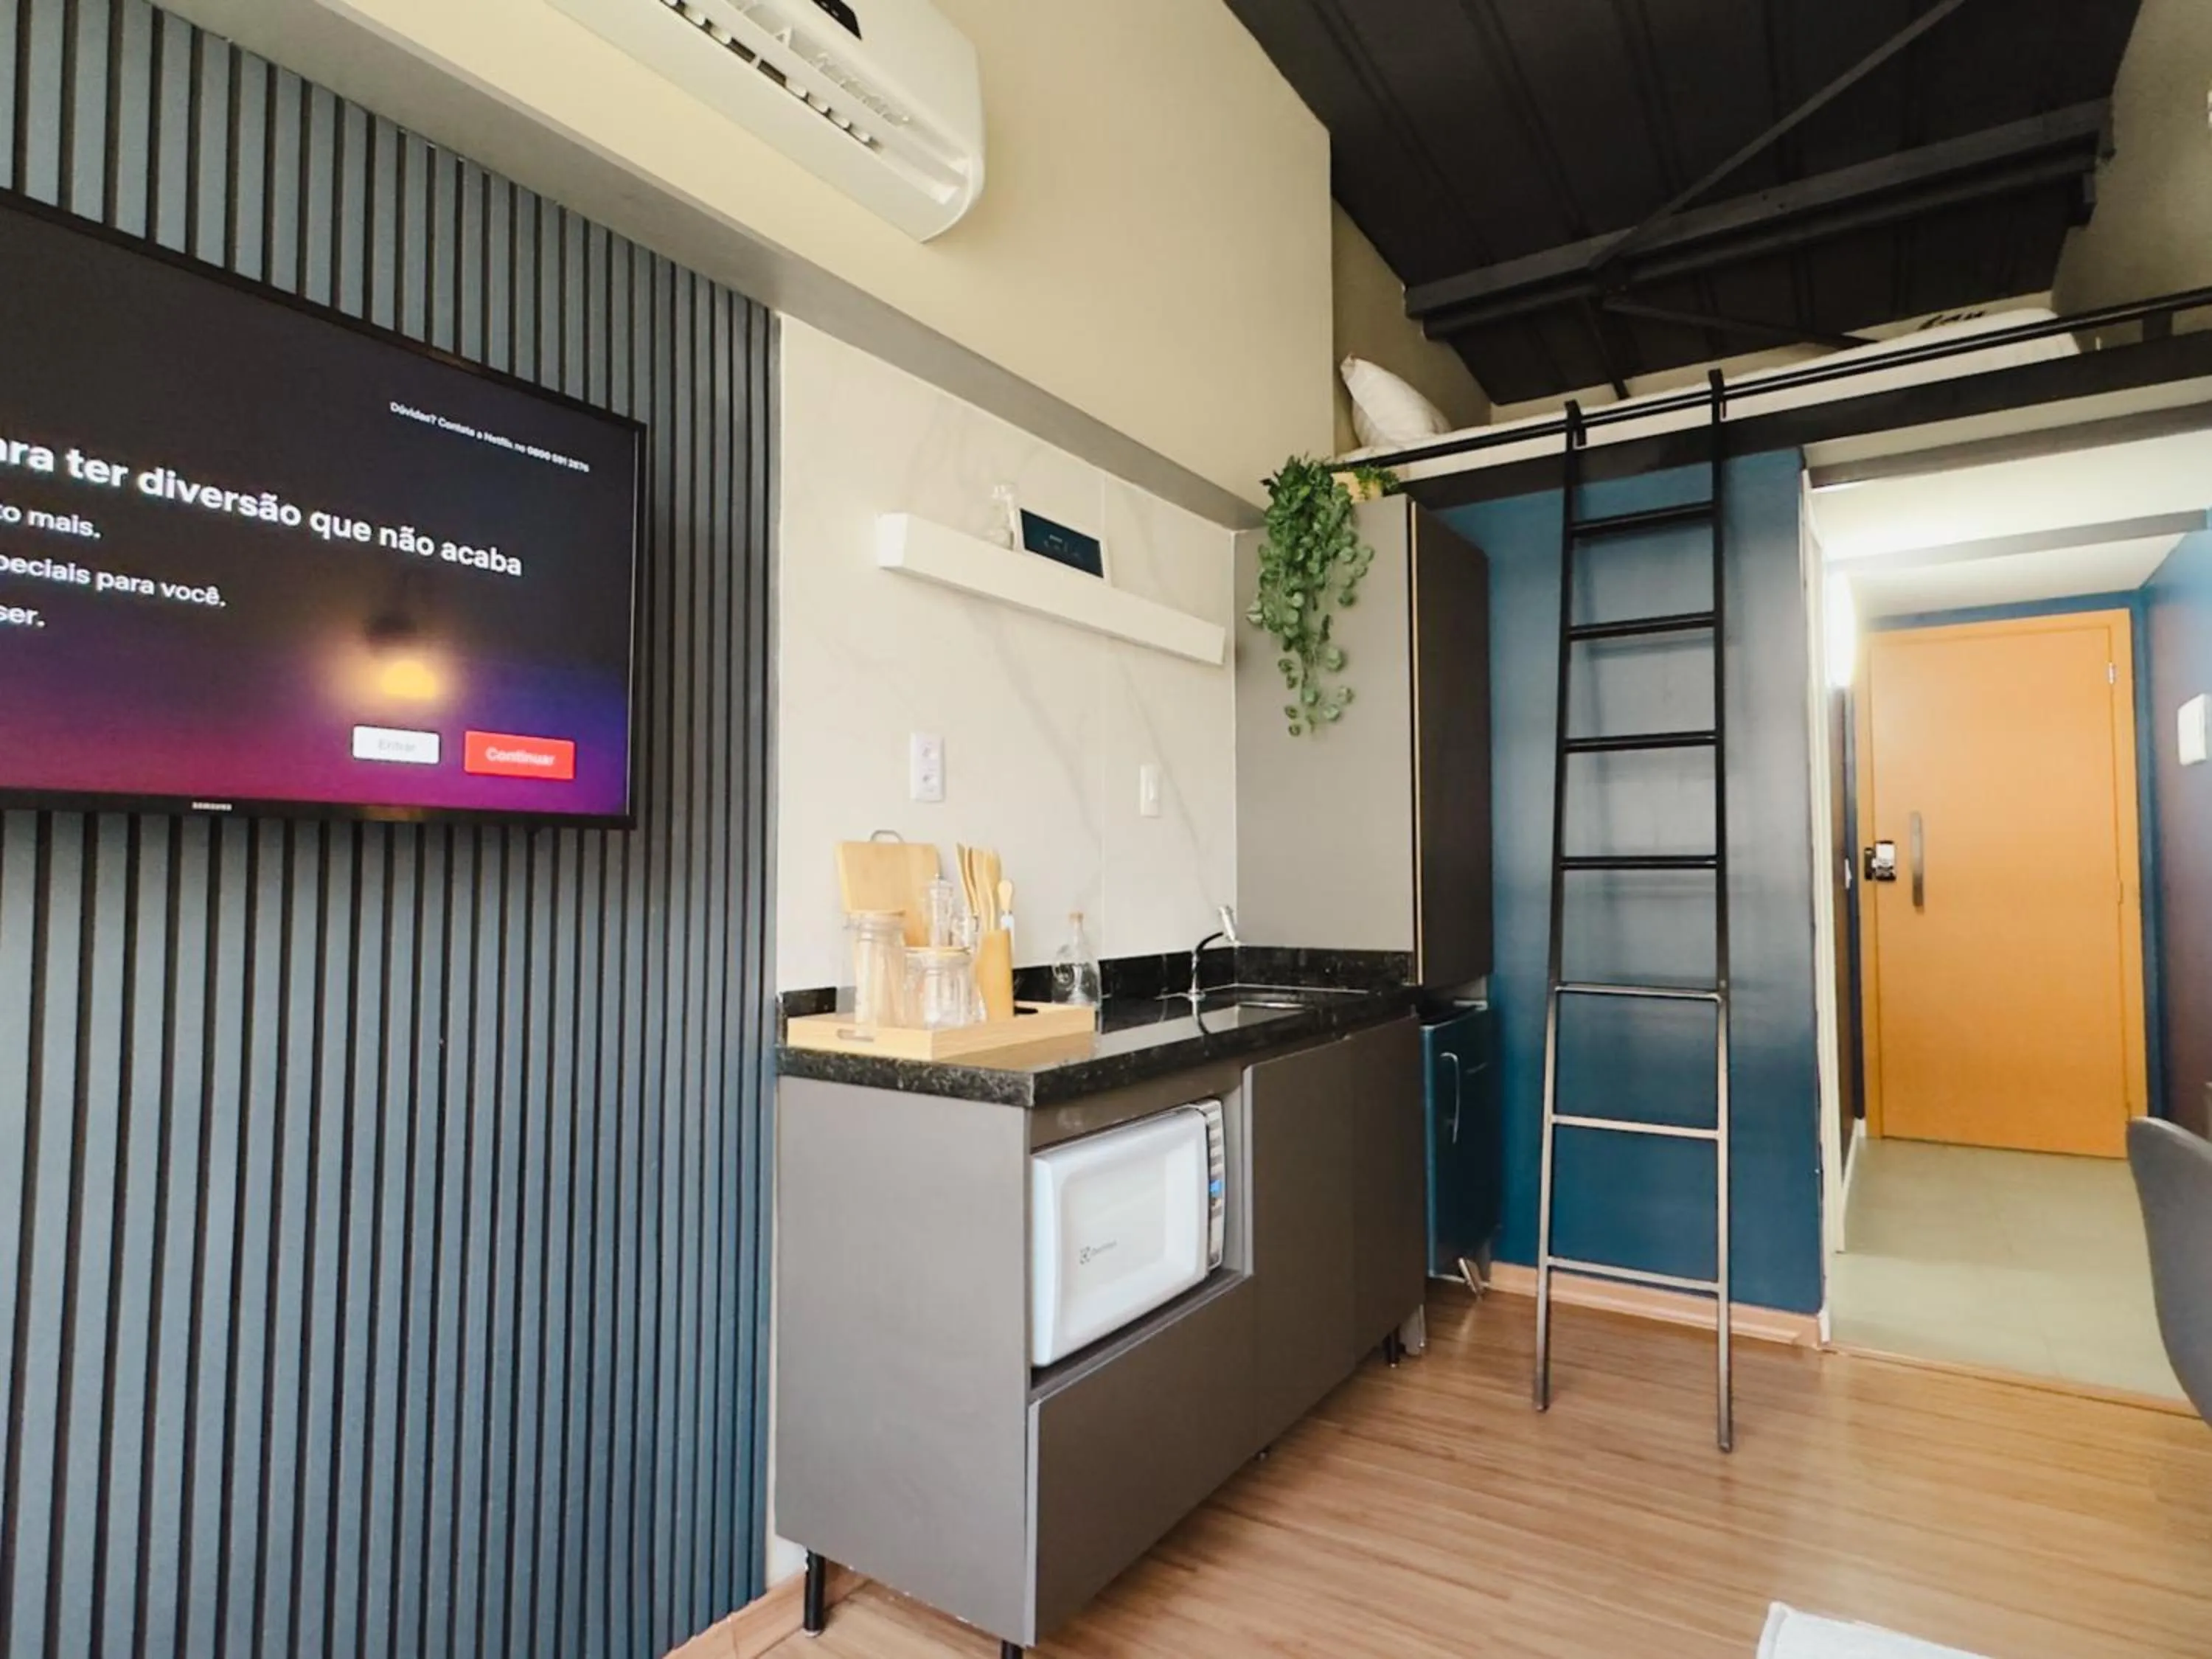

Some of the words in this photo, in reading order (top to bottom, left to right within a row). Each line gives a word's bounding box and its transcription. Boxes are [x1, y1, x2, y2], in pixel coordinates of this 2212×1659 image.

[0, 504, 22, 523] o
[28, 508, 101, 539] mais.
[65, 448, 128, 487] ter
[137, 467, 302, 526] diversão
[310, 510, 372, 542] que
[379, 524, 434, 556] não
[442, 541, 522, 576] acaba
[96, 571, 154, 595] para
[161, 582, 226, 607] você.
[485, 746, 555, 766] Continuar
